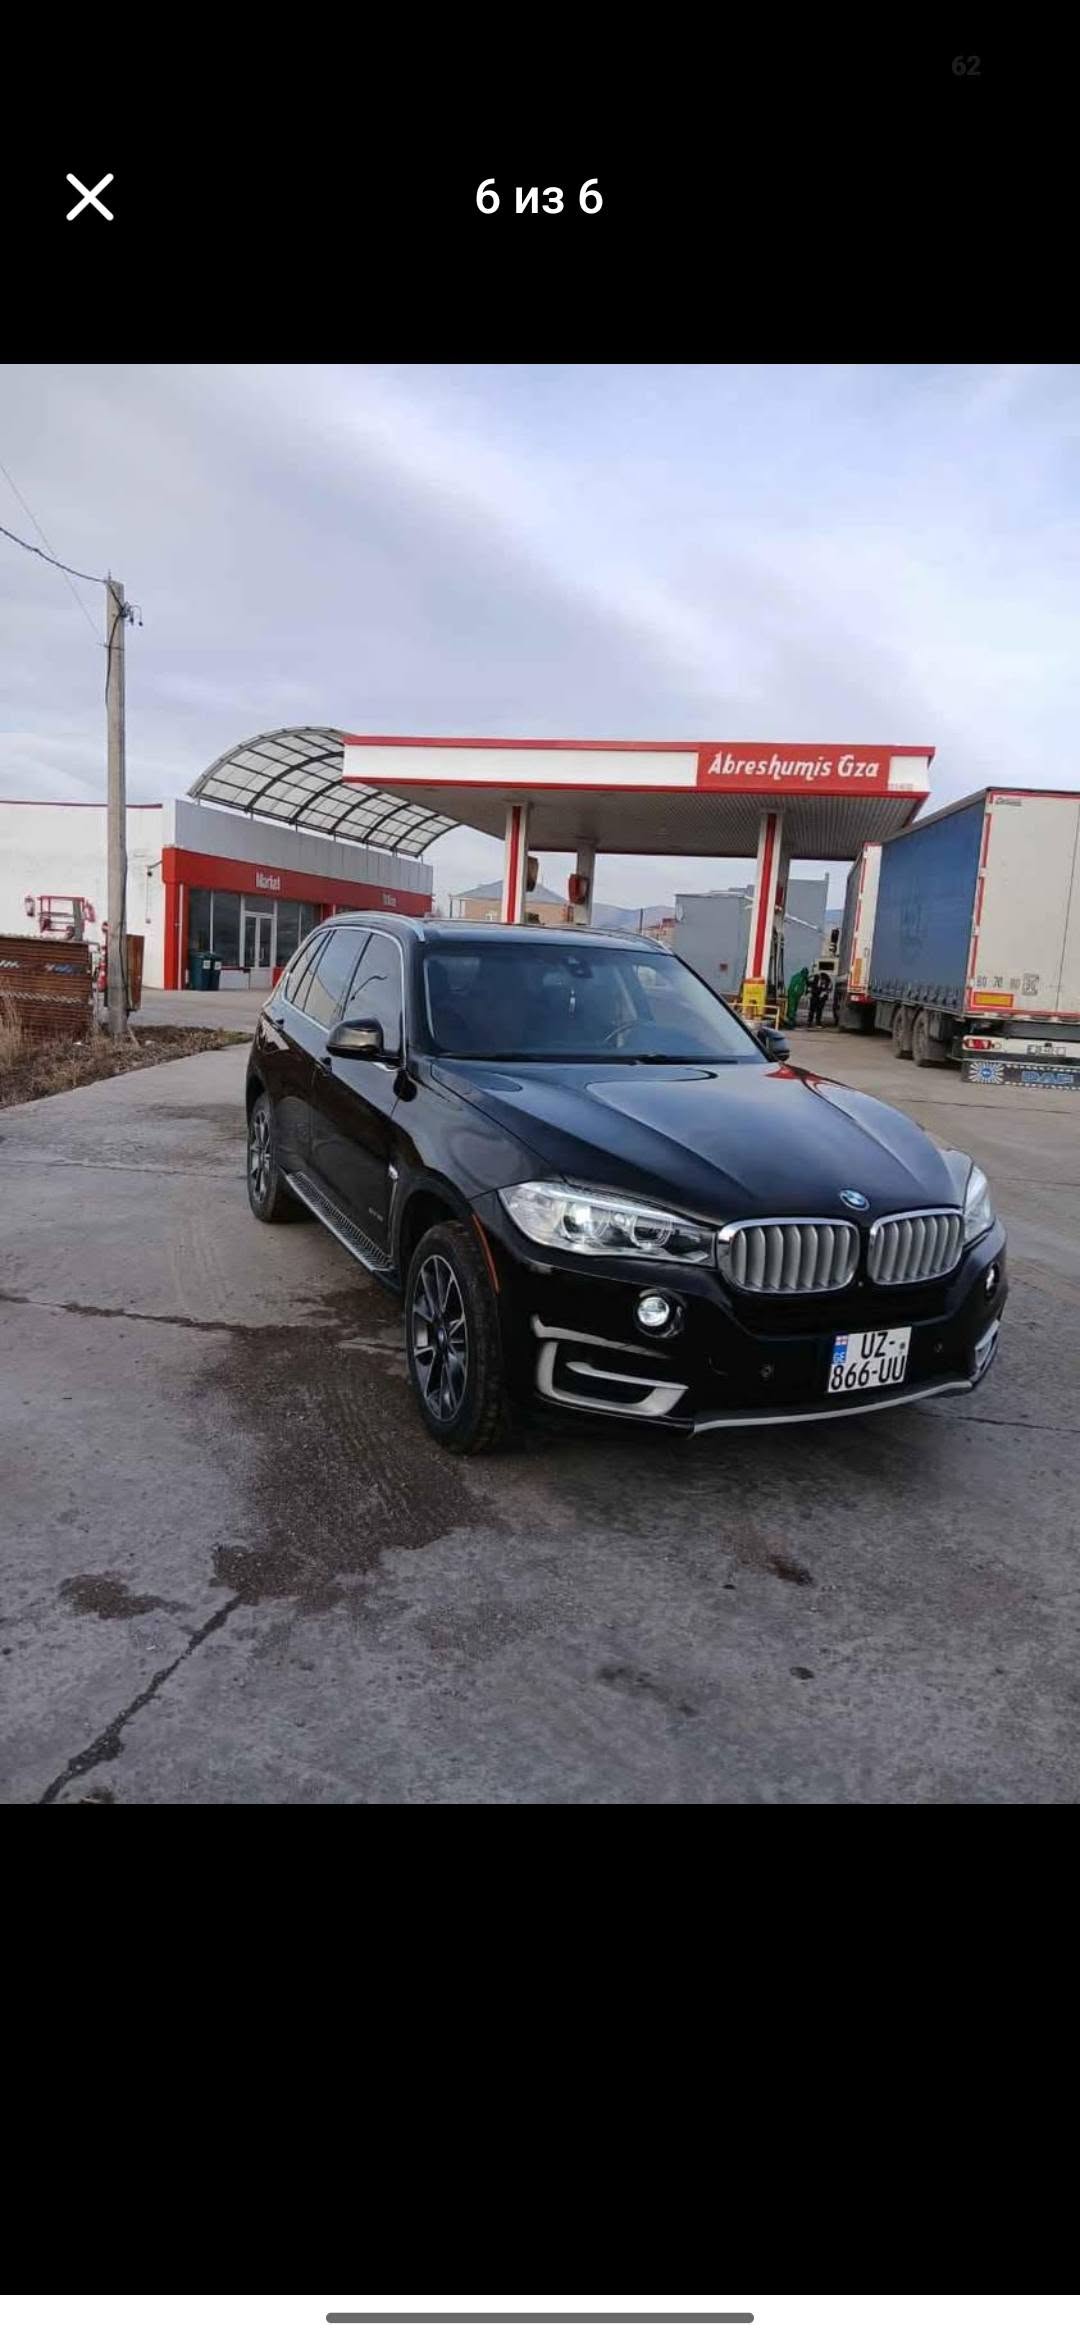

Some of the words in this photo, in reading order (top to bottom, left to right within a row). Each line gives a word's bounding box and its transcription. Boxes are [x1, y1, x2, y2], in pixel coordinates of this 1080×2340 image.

[708, 751, 832, 781] Abreshumis
[838, 754, 880, 778] Gza
[830, 1354, 906, 1391] 866-UU
